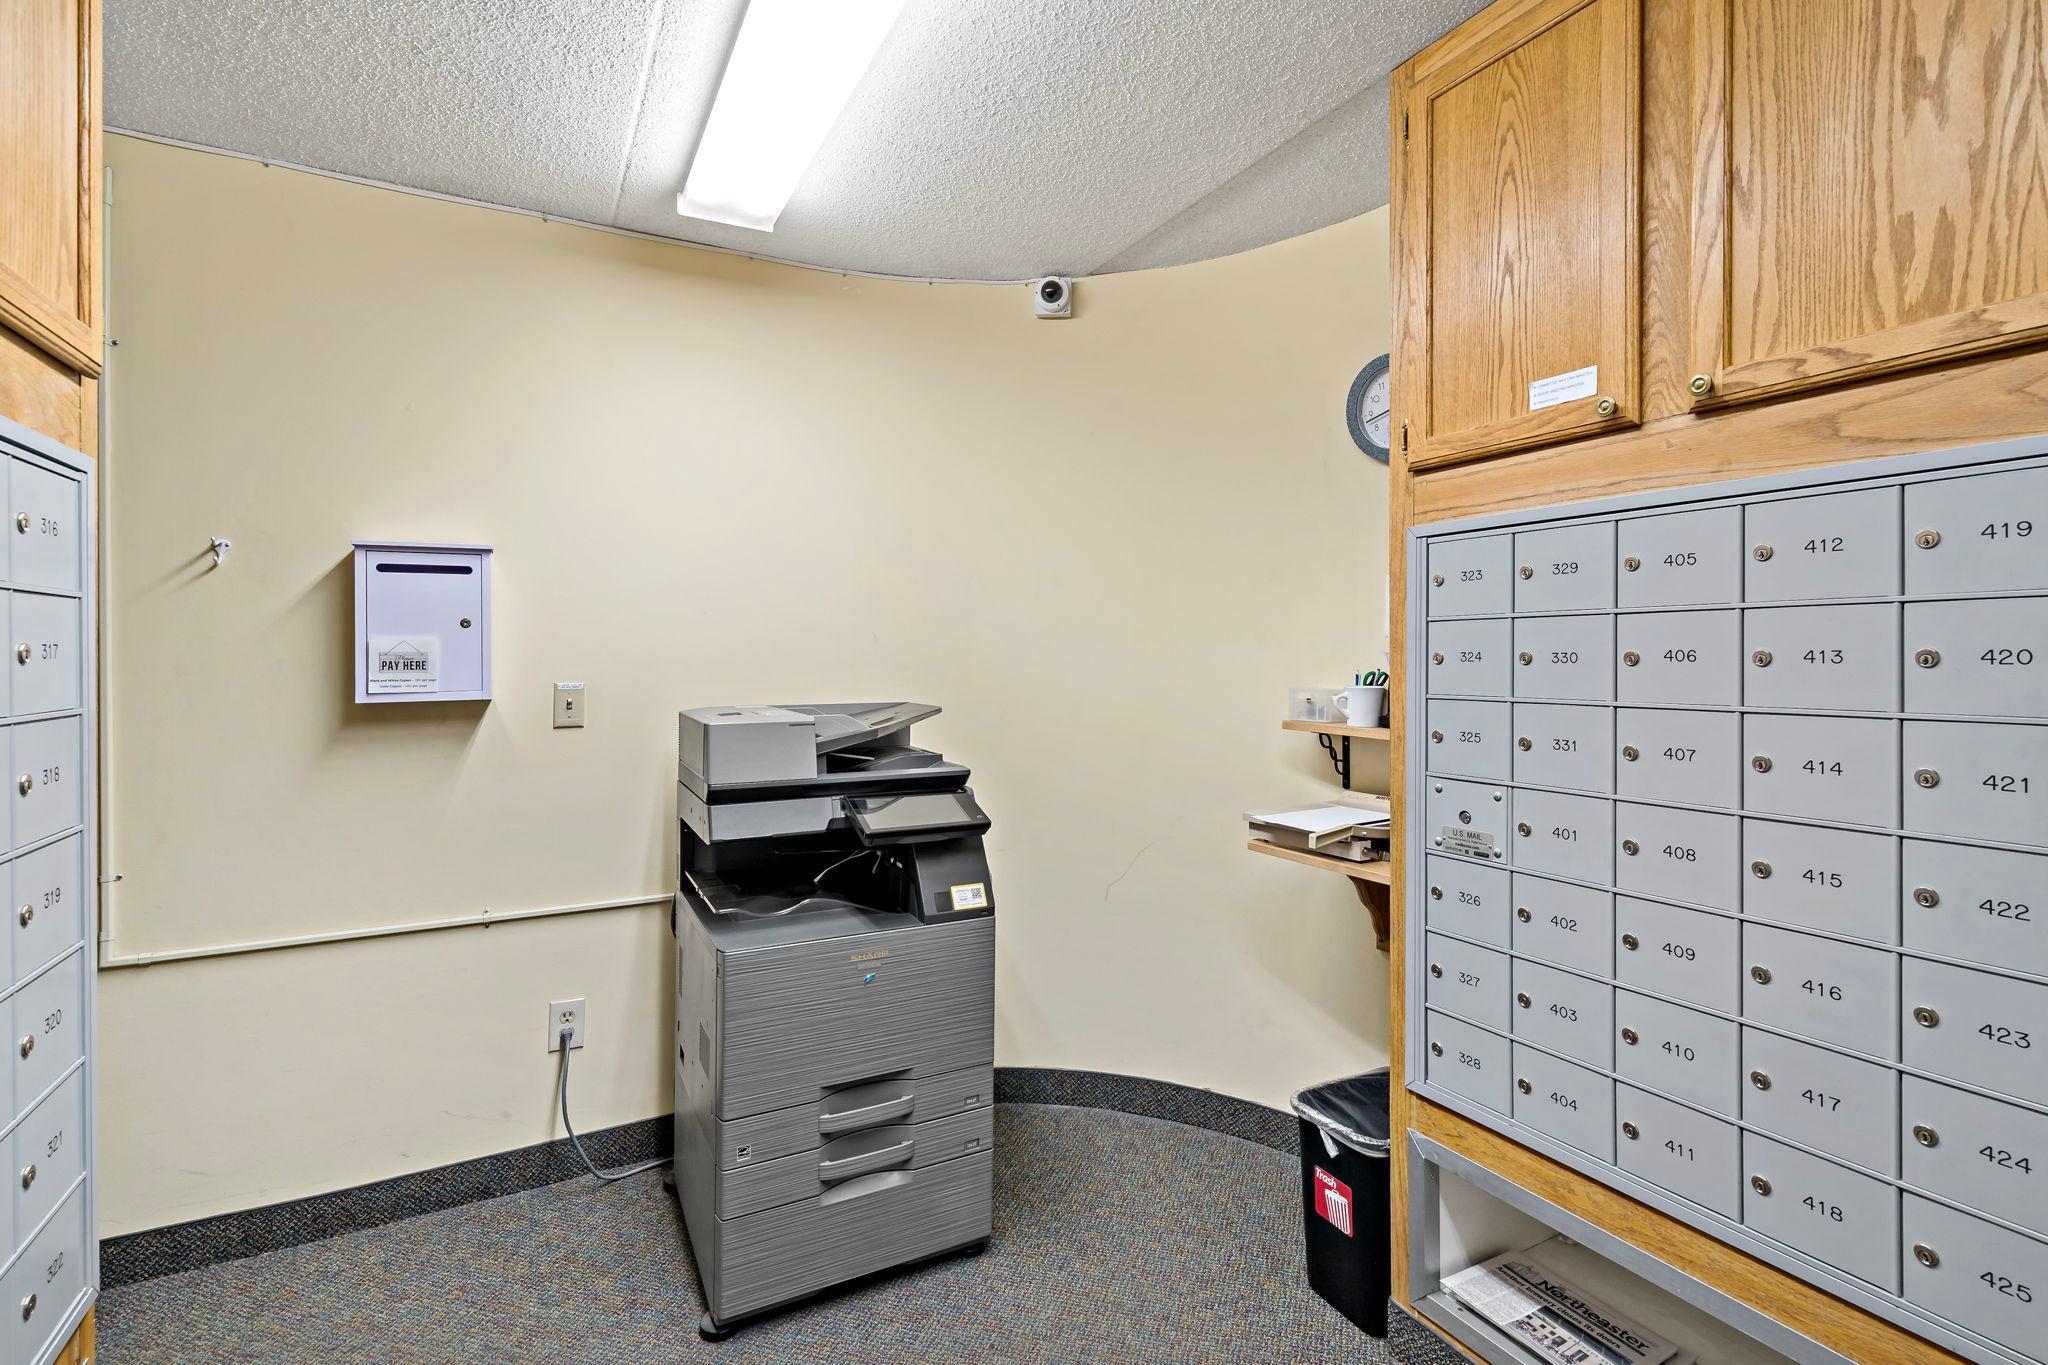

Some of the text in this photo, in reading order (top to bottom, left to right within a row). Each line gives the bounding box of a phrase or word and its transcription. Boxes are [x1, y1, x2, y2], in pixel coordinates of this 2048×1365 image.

[1378, 382, 1386, 391] 11
[1374, 423, 1380, 432] 8
[40, 517, 58, 537] 316
[1980, 520, 2033, 540] 419
[1804, 537, 1844, 554] 412
[1552, 561, 1579, 576] 329
[1663, 552, 1697, 567] 405
[1460, 569, 1483, 582] 323
[41, 643, 59, 660] 317
[1460, 651, 1483, 663] 324
[1551, 651, 1579, 664] 330
[1663, 649, 1697, 663] 406
[1803, 649, 1844, 665] 413
[1980, 648, 2034, 666] 420
[381, 660, 427, 671] PAY HERE
[1459, 731, 1482, 744] 325
[1552, 738, 1577, 752] 331
[1663, 747, 1696, 762] 407
[42, 766, 60, 786] 318
[1802, 759, 1844, 777] 414
[1982, 774, 2029, 794] 421
[1452, 829, 1482, 840] U.S. MAIL
[1552, 827, 1577, 842] 401
[1662, 844, 1697, 862] 408
[1802, 869, 1843, 889] 415
[43, 887, 61, 909] 319
[1458, 891, 1481, 907] 326
[1978, 899, 2031, 922] 422
[1550, 915, 1578, 933] 402
[848, 949, 889, 961] SHARP
[1662, 942, 1696, 962] 409
[1458, 971, 1481, 988] 327
[1801, 979, 1842, 1001] 416
[44, 1008, 62, 1035] 320
[1549, 1003, 1578, 1022] 403
[1978, 1023, 2031, 1049] 423
[1458, 1051, 1481, 1070] 328
[1661, 1040, 1695, 1062] 410
[1550, 1091, 1578, 1112] 404
[1801, 1089, 1841, 1112] 417
[47, 1130, 63, 1158] 321
[1664, 1139, 1694, 1162] 411
[1978, 1145, 2033, 1175] 424
[1315, 1167, 1337, 1189] Trash
[1802, 1196, 1843, 1223] 418
[46, 1251, 64, 1284] 322
[1979, 1271, 2033, 1304] 425
[1496, 1265, 1527, 1288] Another
[1526, 1285, 1558, 1308] brewery
[1557, 1304, 1582, 1325] closes
[1583, 1323, 1596, 1333] its
[1596, 1331, 1622, 1349] doors
[1535, 1279, 1651, 1350] Northeaster
